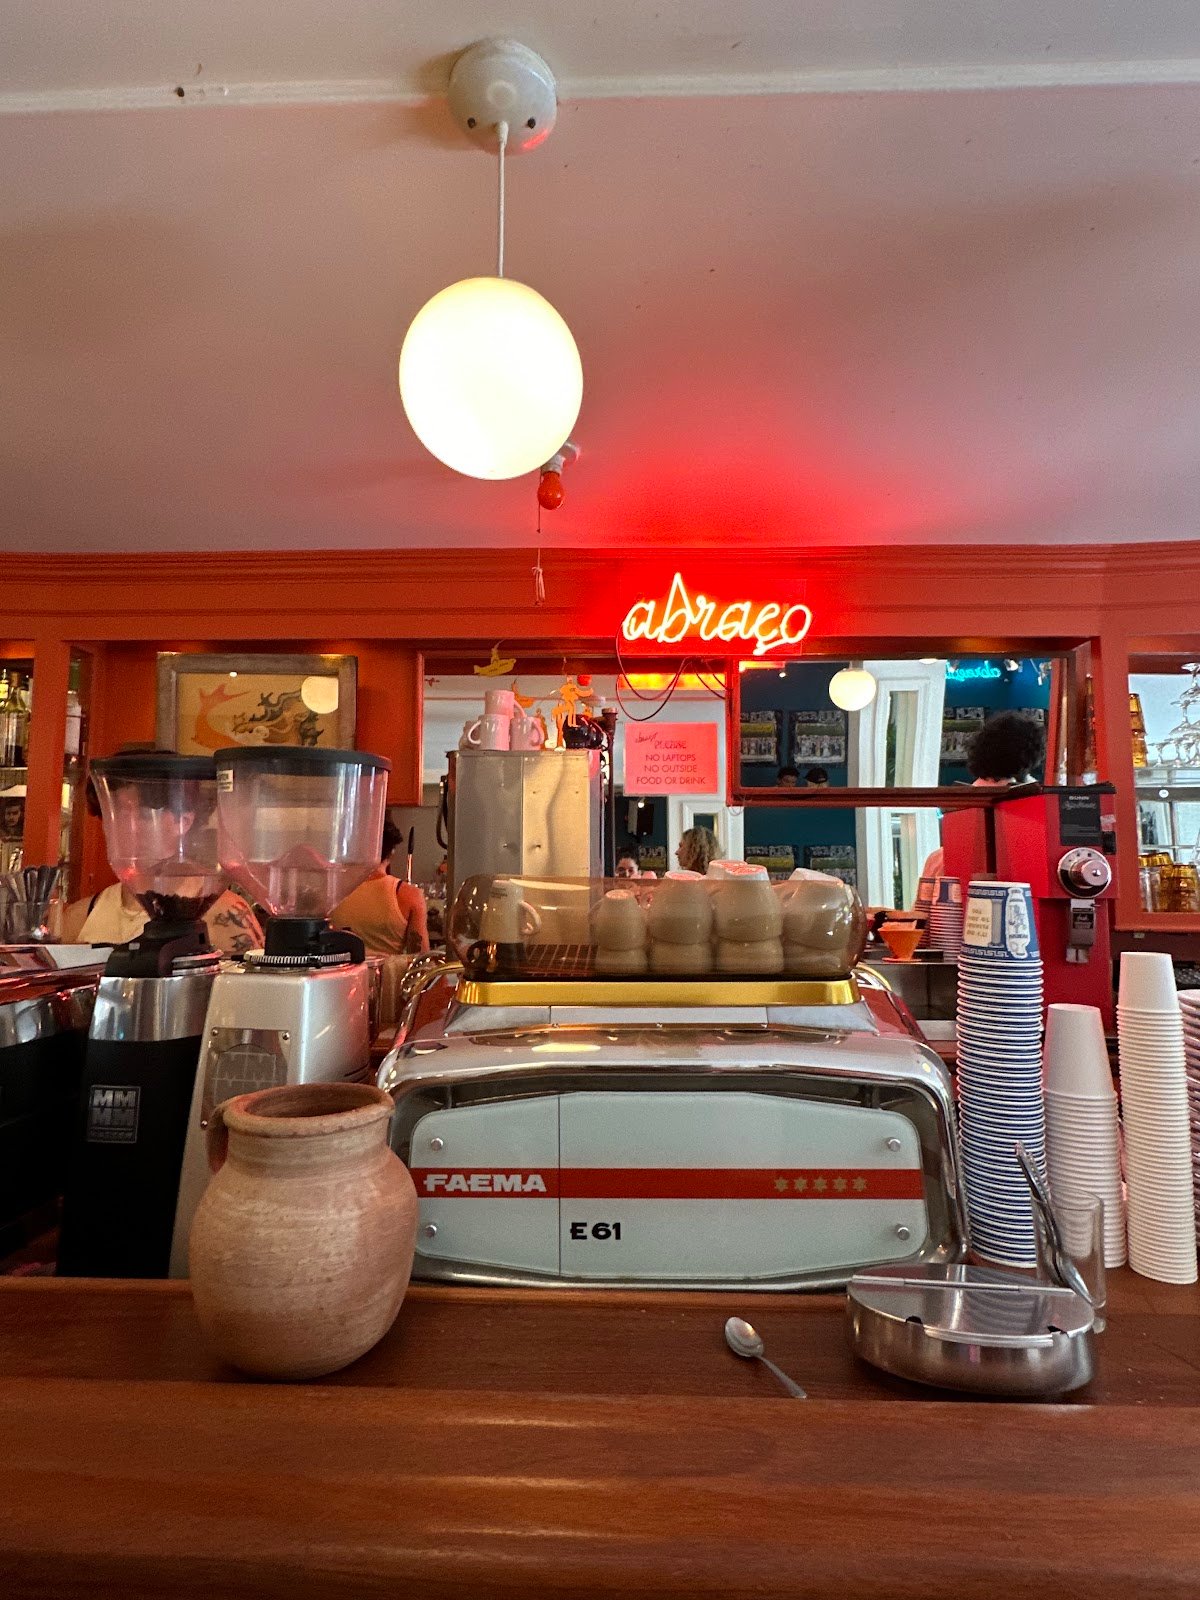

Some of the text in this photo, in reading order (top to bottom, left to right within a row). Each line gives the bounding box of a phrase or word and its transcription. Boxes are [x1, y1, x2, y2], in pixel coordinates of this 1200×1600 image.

[645, 754, 697, 762] NO LAPTOPS
[644, 765, 697, 773] NO OUTSIDE
[636, 777, 706, 785] FOOD OR DRINK
[424, 1174, 547, 1192] FAEMA
